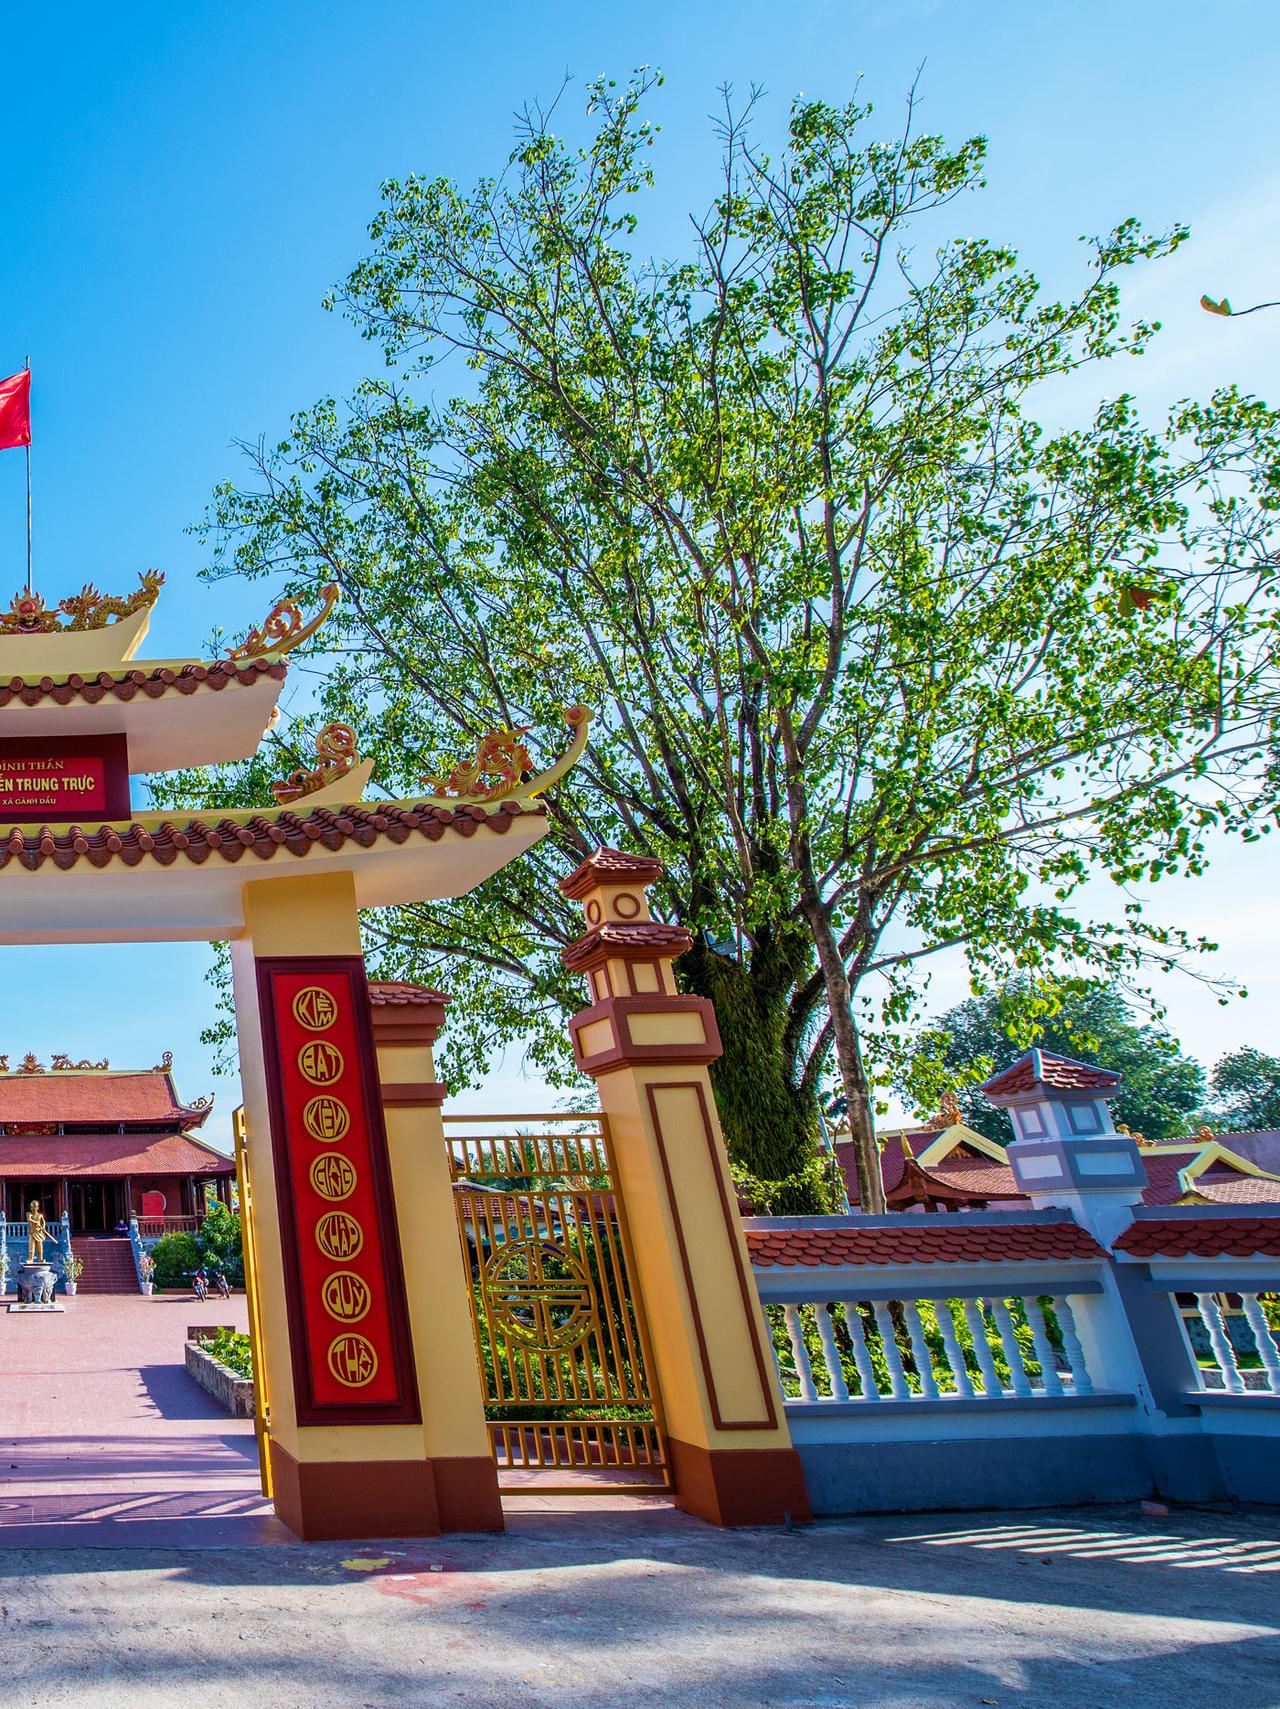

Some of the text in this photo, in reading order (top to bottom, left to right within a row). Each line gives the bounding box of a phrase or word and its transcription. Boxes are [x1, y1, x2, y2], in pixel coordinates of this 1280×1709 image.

[16, 777, 58, 792] TRUNG
[61, 775, 95, 794] TRỰC
[303, 1045, 338, 1082] BẠT
[308, 1099, 345, 1137] KIÊN
[314, 1156, 351, 1197] GIANG
